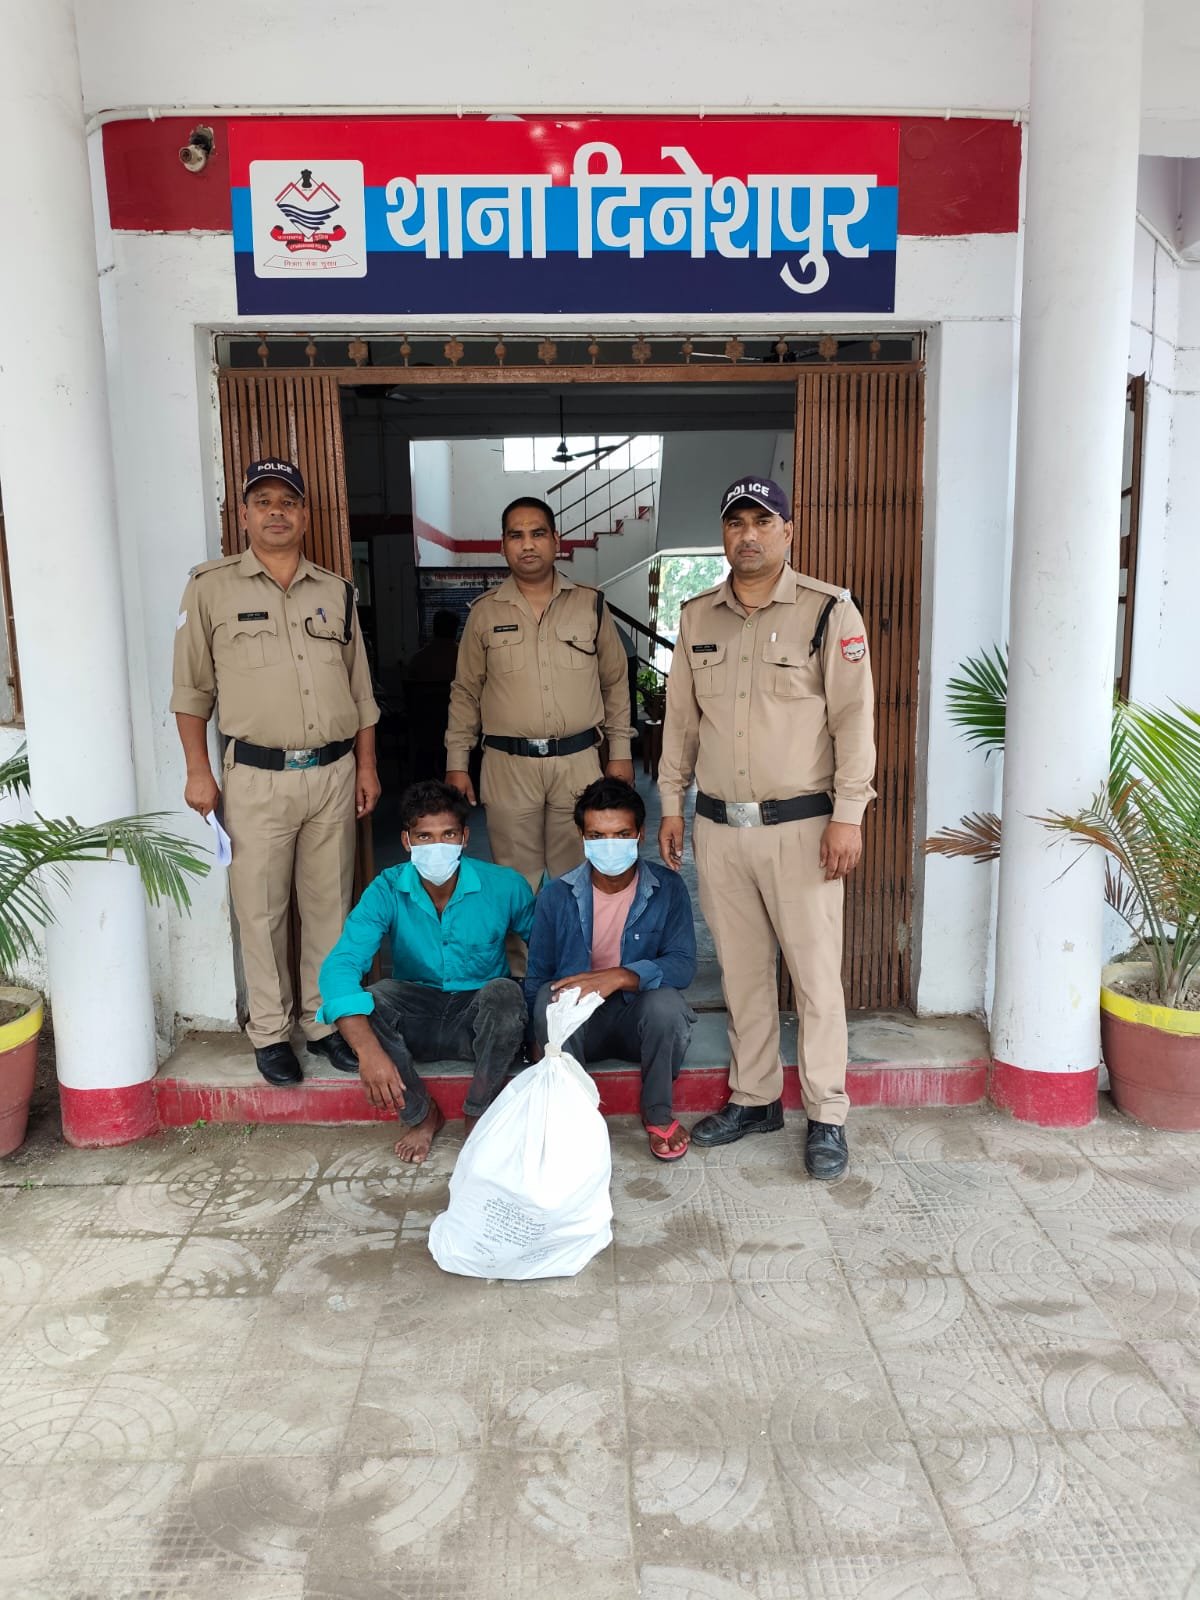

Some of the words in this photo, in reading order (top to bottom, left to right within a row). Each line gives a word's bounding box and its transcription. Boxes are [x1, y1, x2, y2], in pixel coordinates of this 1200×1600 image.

[386, 173, 553, 260] थाना
[570, 142, 878, 294] दिनेशपुर
[257, 462, 293, 474] POLICE
[727, 483, 769, 501] POLICE
